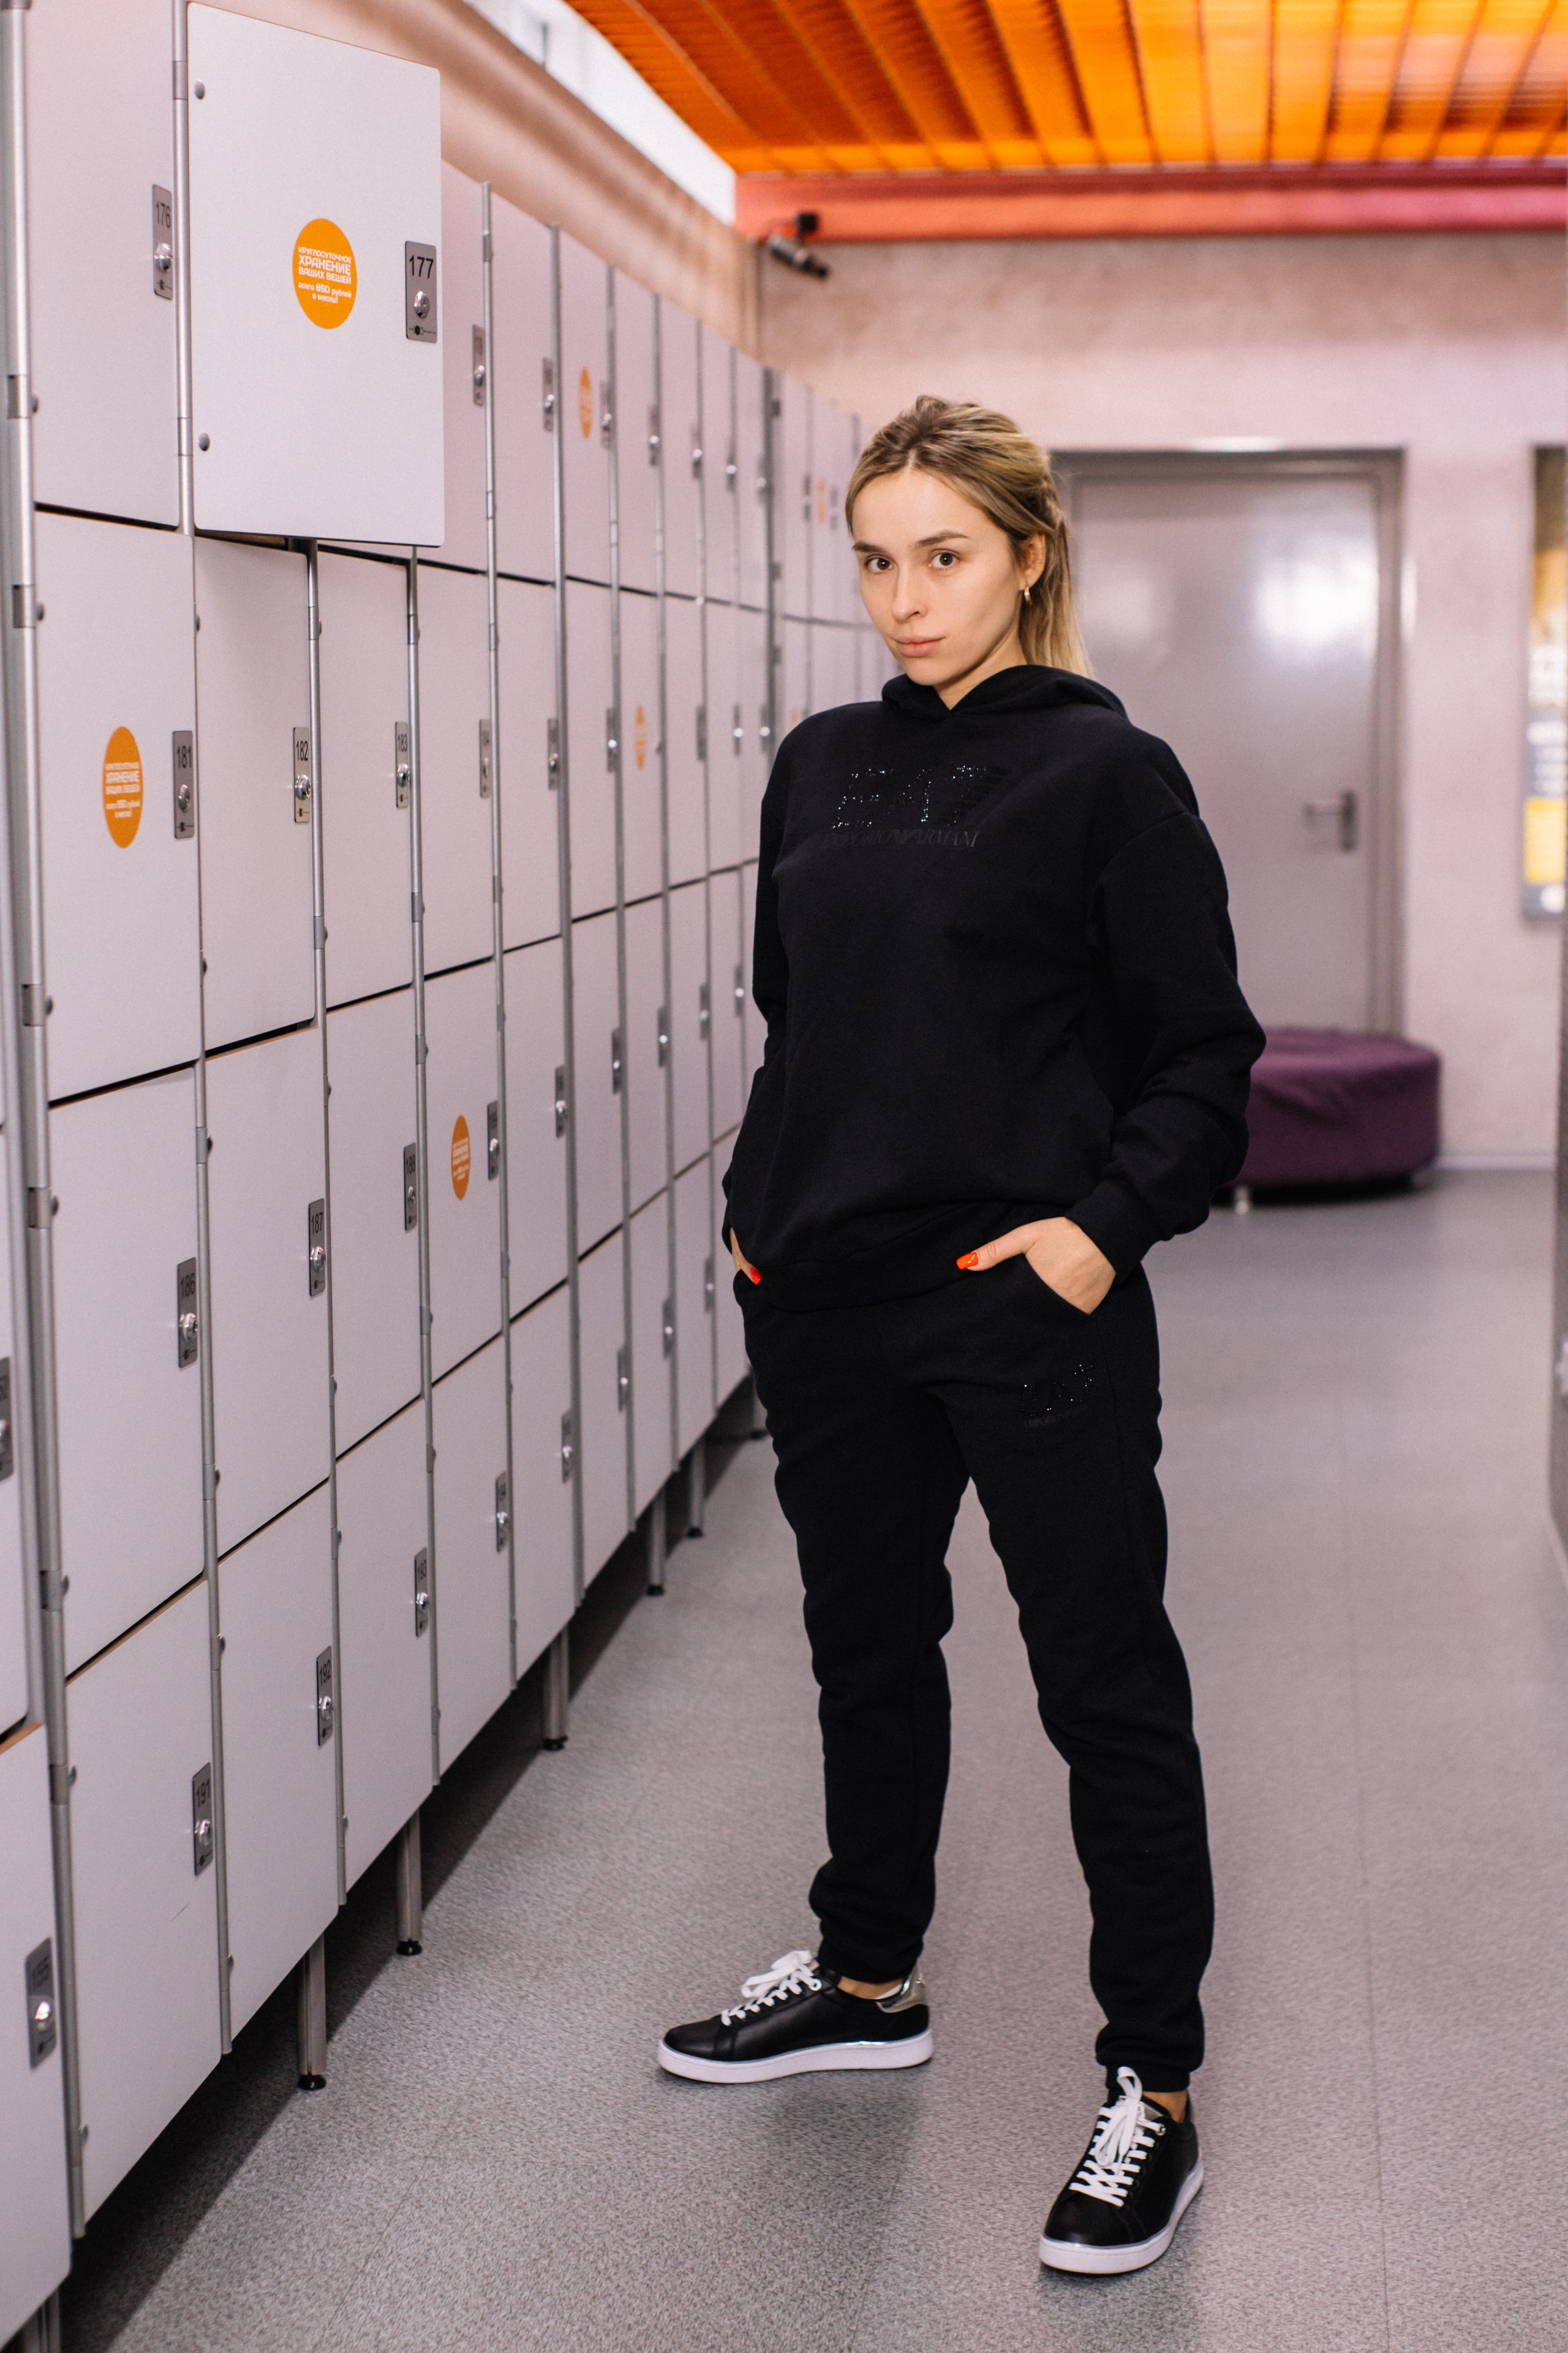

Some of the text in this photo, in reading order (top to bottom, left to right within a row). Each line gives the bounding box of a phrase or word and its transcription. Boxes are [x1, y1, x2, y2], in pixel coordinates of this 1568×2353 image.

[156, 201, 171, 229] 176
[298, 246, 352, 263] КРУГЛОСУТОЧНОЕ
[299, 255, 352, 274] ХРАНЕНИЕ
[298, 266, 325, 279] ВАШИХ
[409, 255, 434, 279] 177
[316, 284, 330, 293] 950
[296, 741, 308, 761] 182
[398, 733, 408, 752] 183
[176, 746, 192, 768] 181
[406, 1154, 416, 1175] 188
[311, 1212, 323, 1234] 187
[320, 1660, 331, 1686] 192
[197, 1778, 210, 1808] 191
